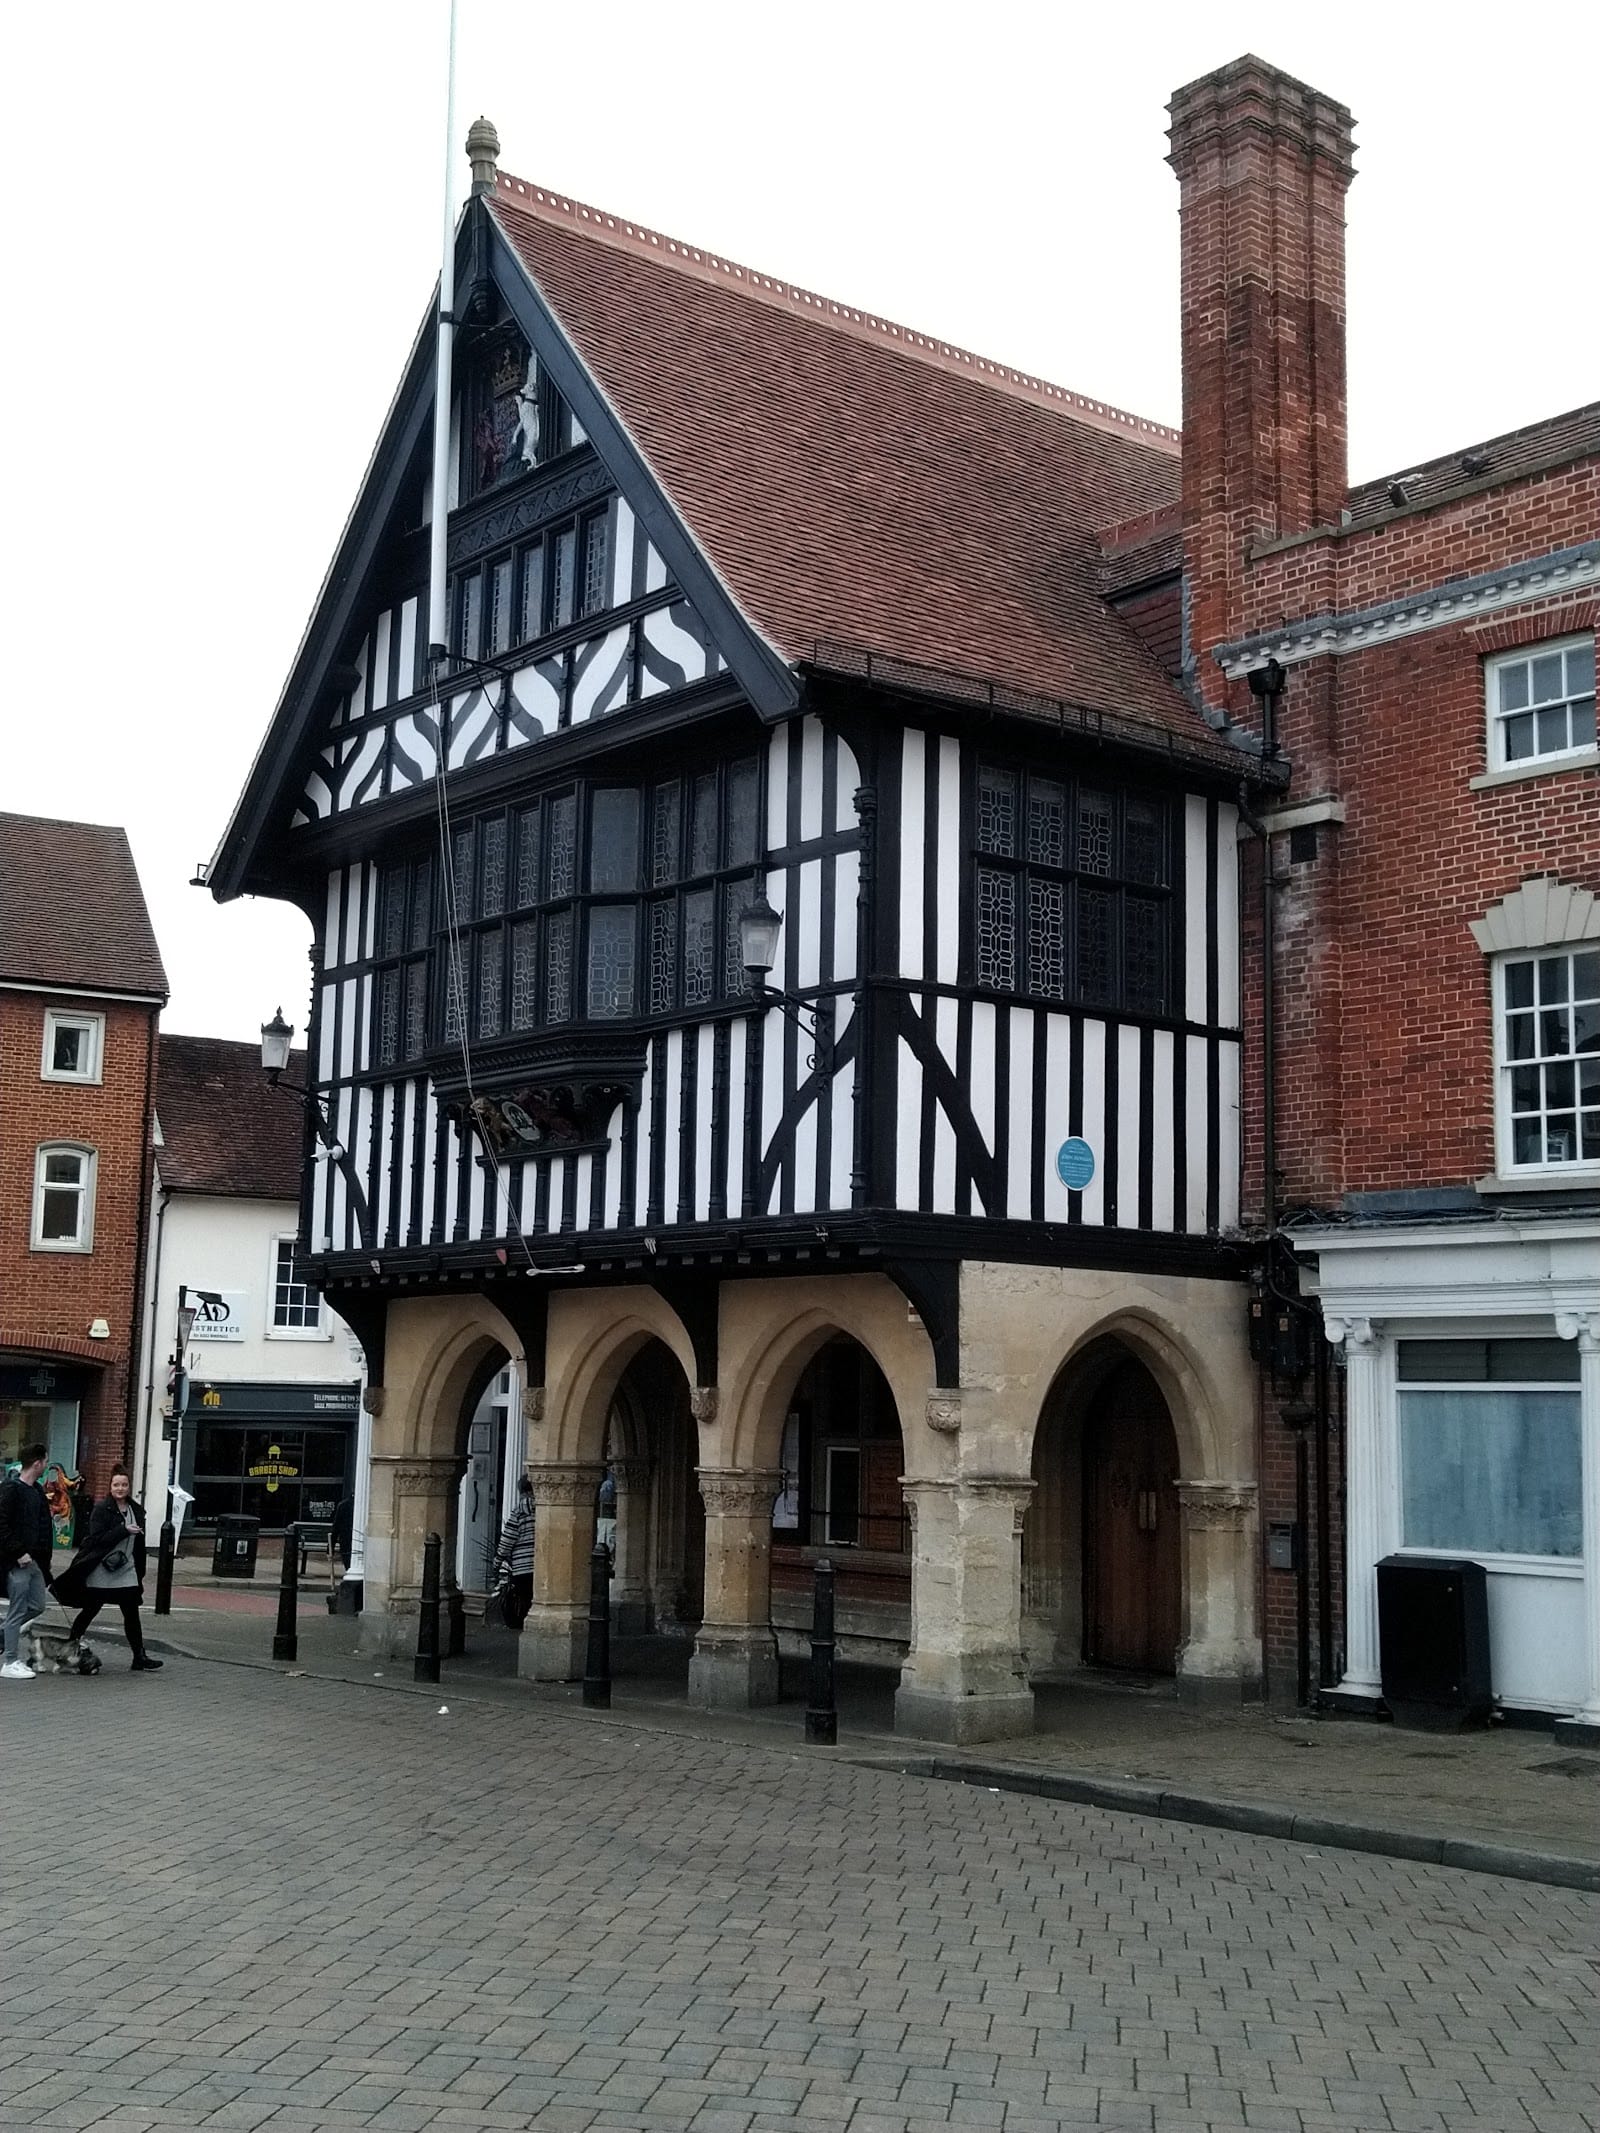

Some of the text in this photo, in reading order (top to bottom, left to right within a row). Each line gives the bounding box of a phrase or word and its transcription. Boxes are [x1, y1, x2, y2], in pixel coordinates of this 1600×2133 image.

[191, 1325, 240, 1333] ESTHETICS
[249, 1465, 299, 1477] BARBER SHOP
